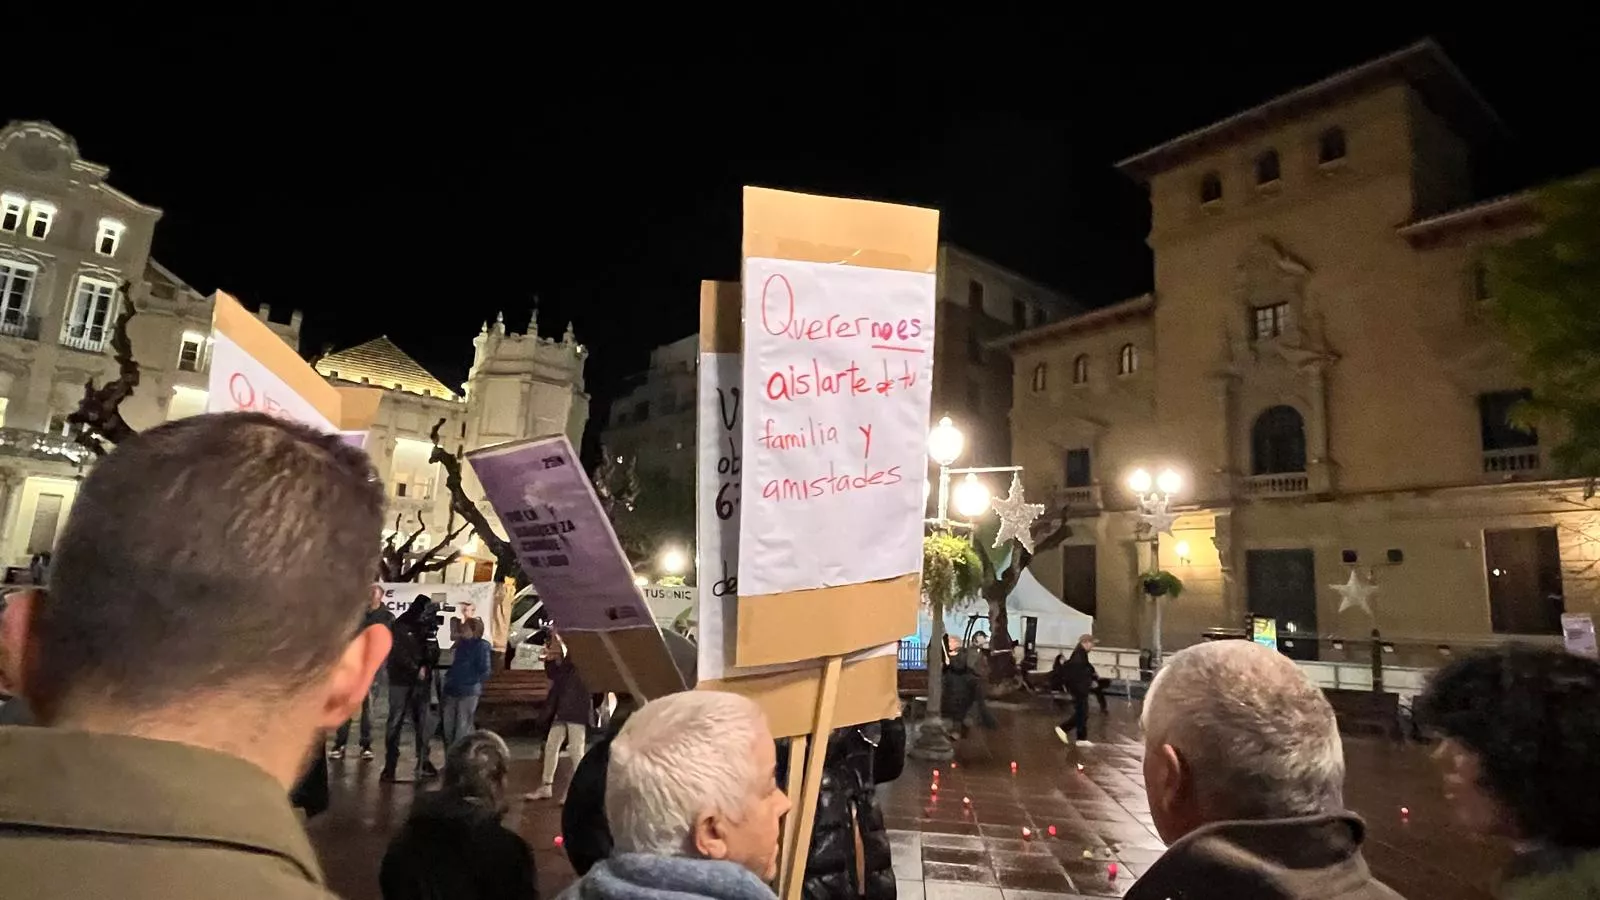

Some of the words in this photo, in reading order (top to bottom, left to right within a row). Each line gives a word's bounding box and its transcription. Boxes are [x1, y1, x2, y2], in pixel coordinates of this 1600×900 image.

[762, 273, 870, 340] Querer
[871, 321, 893, 341] no
[896, 318, 922, 341] es
[766, 358, 872, 402] aislarte
[716, 387, 740, 431] V
[758, 416, 839, 450] familia
[858, 423, 873, 459] y
[762, 461, 903, 502] amistades
